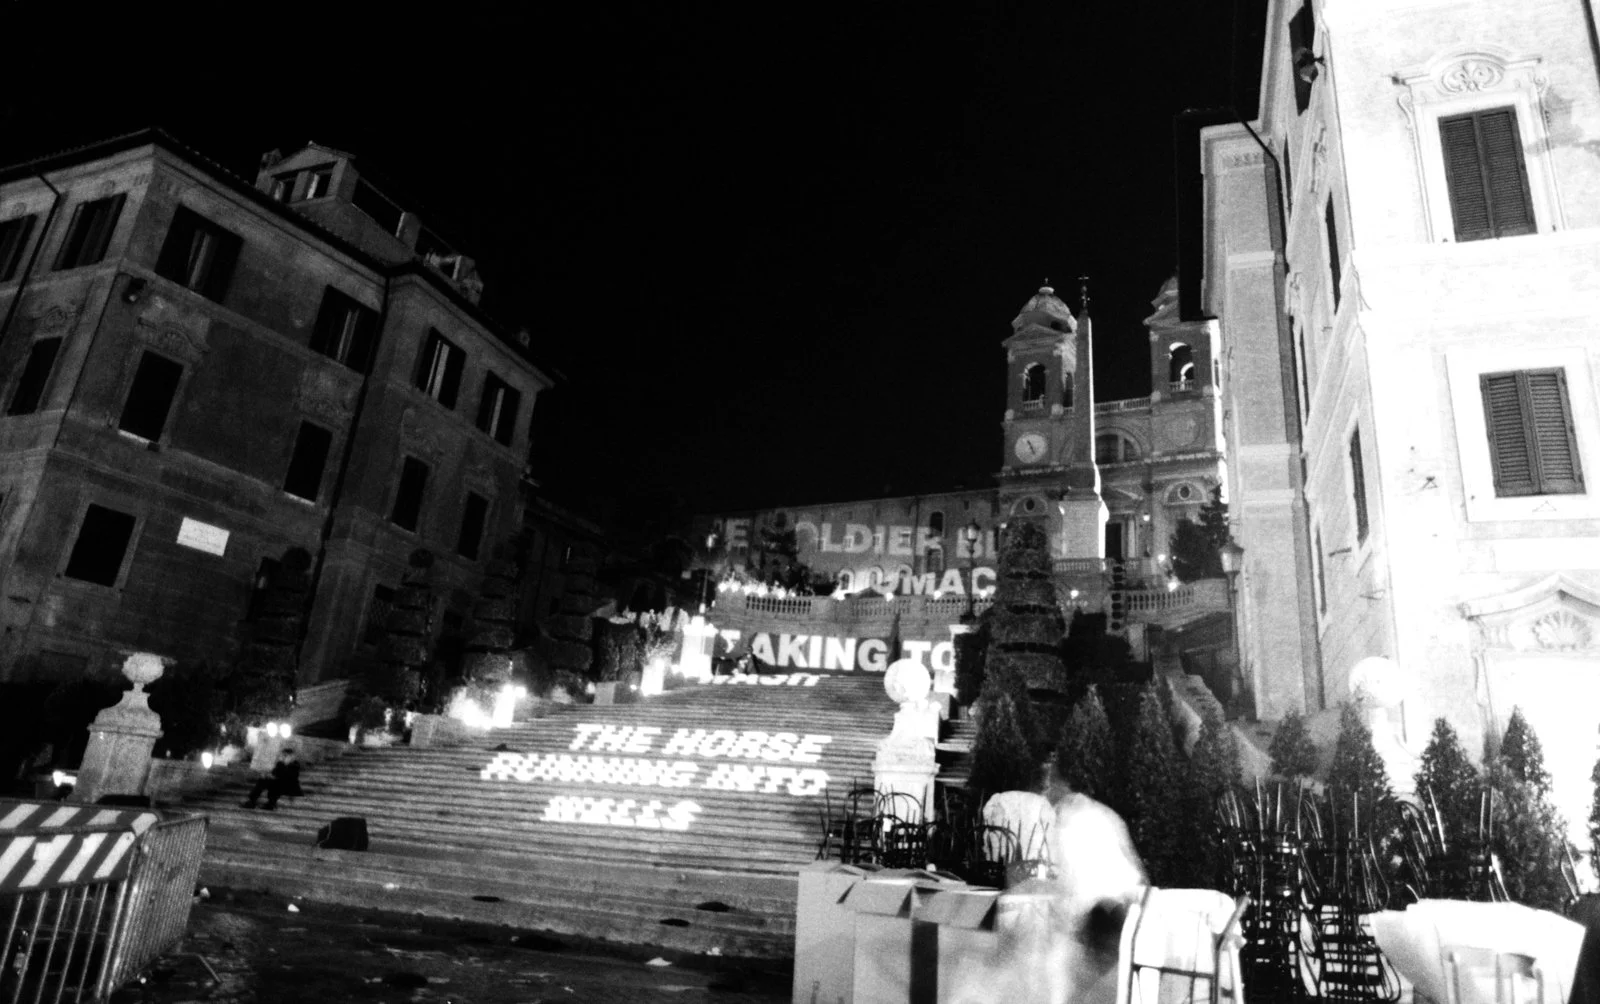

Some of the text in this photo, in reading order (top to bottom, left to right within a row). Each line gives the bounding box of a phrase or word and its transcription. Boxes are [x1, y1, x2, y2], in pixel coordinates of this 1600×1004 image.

[775, 521, 943, 556] OLDIER
[568, 723, 832, 763] THE HORSE
[480, 753, 699, 787] RUNNING
